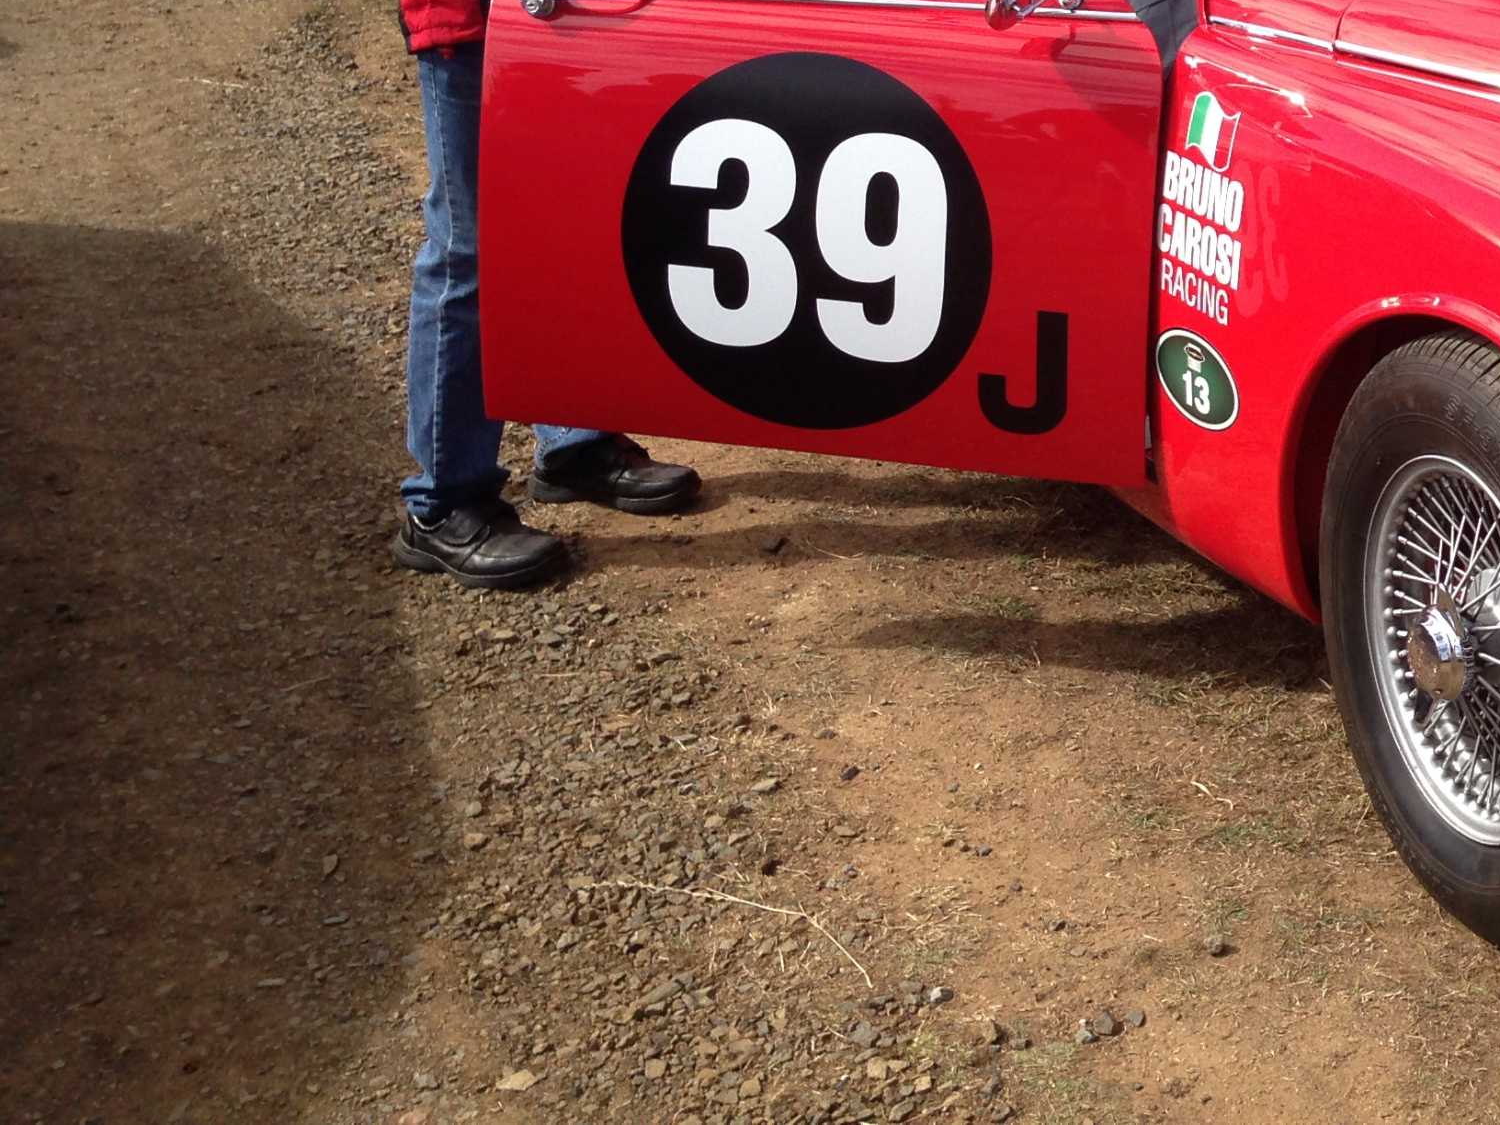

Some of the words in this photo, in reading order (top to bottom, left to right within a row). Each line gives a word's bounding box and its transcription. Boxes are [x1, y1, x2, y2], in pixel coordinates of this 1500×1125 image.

[1162, 150, 1245, 233] BRUNO
[667, 118, 948, 363] 39
[1158, 203, 1242, 291] CAROSI
[1160, 257, 1229, 326] RACING
[978, 311, 1068, 435] J
[1182, 369, 1211, 415] 13
